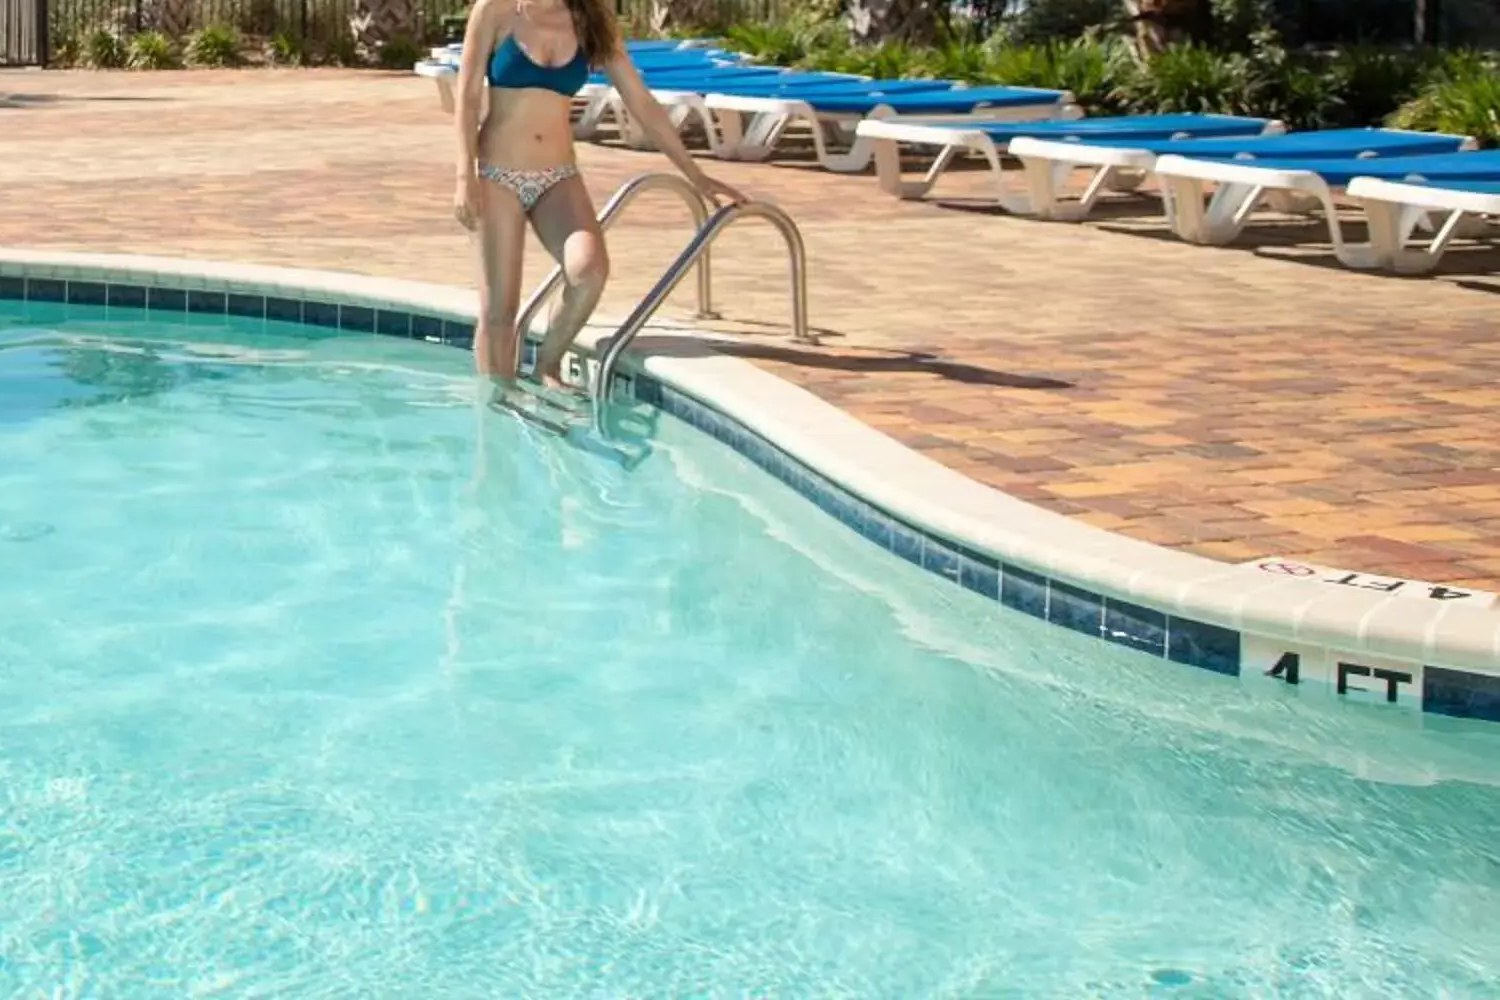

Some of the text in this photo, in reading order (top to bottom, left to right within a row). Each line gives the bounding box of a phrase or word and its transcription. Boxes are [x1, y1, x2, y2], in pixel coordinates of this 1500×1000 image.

[1323, 573, 1473, 601] 4 FT
[1264, 651, 1413, 703] 4 FT
